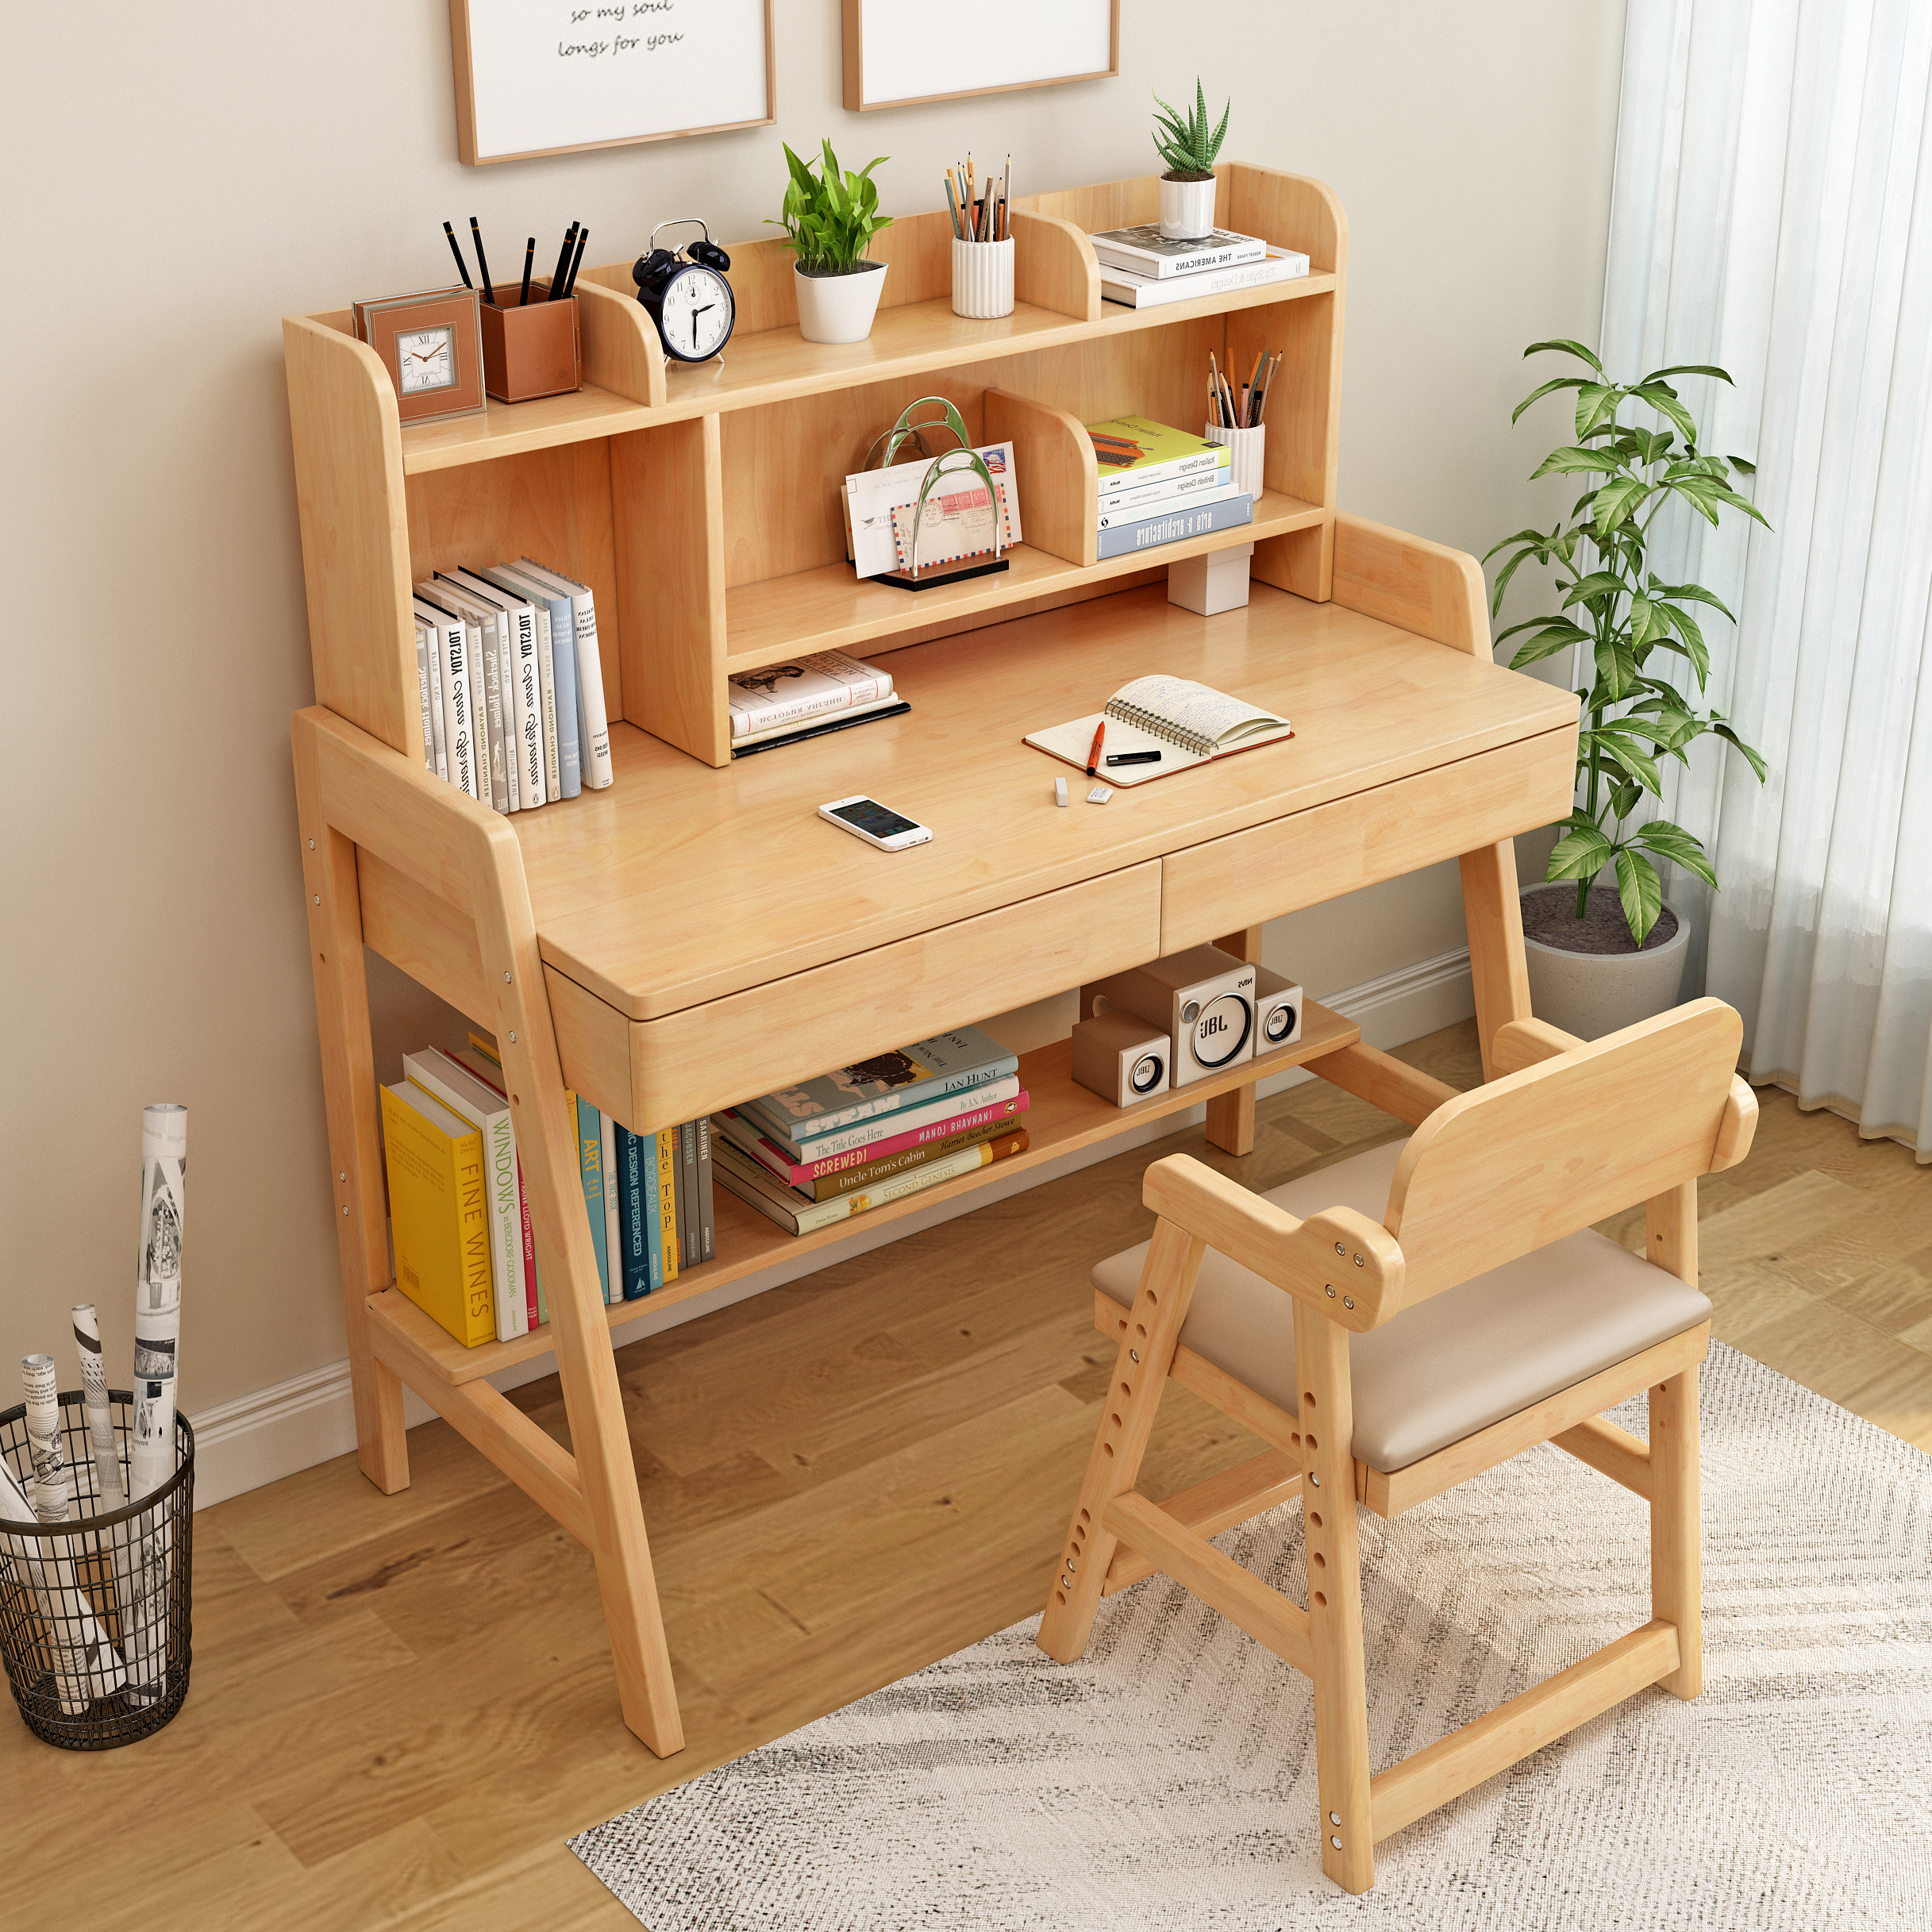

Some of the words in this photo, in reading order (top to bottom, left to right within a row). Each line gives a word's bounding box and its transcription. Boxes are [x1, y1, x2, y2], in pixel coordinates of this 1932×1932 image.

[571, 10, 589, 24] so
[597, 6, 625, 21] my
[633, 0, 673, 15] soul
[558, 41, 608, 58] longs
[612, 35, 641, 56] for
[647, 33, 684, 51] you
[676, 283, 683, 291] 11
[688, 275, 696, 285] 12
[668, 297, 675, 306] 10
[719, 302, 725, 312] 3
[664, 314, 670, 325] 9
[716, 320, 722, 329] 4
[418, 335, 429, 345] XII
[670, 331, 675, 340] 8
[681, 340, 687, 350] 7
[710, 333, 714, 344] 5
[1199, 1014, 1228, 1039] JBL
[945, 1079, 964, 1092] IAN
[967, 1068, 998, 1086] HUNT
[816, 1144, 831, 1157] The
[831, 1138, 848, 1152] Title
[848, 1135, 866, 1147] Goes
[867, 1129, 883, 1140] Here
[960, 1101, 967, 1112] By
[968, 1097, 979, 1107] A.N.
[980, 1092, 998, 1104] Author
[918, 1124, 946, 1143] MANOJ
[951, 1110, 993, 1133] BHAVNANI
[493, 1117, 515, 1214] WINDOWS
[584, 1140, 600, 1172] ART
[839, 1171, 868, 1189] Uncle
[868, 1160, 897, 1177] Tom's
[898, 1151, 926, 1167] Cabin
[940, 1137, 965, 1151] Harriet
[967, 1126, 993, 1141] Beecher
[993, 1118, 1016, 1132] Stowe
[629, 1146, 639, 1187] DESIGN
[461, 1164, 482, 1224] FINE
[586, 1191, 603, 1201] Century
[645, 1157, 658, 1216] BORDEAUX
[883, 1181, 918, 1201] SECOND
[921, 1167, 956, 1186] GENESIS
[522, 1206, 531, 1230] LLOYD
[630, 1187, 642, 1257] REFERENCED
[504, 1222, 514, 1260] BERGDORF
[467, 1231, 489, 1318] WINES
[506, 1260, 517, 1299] GOODMAN
[470, 1330, 495, 1344] ASSOULINE
